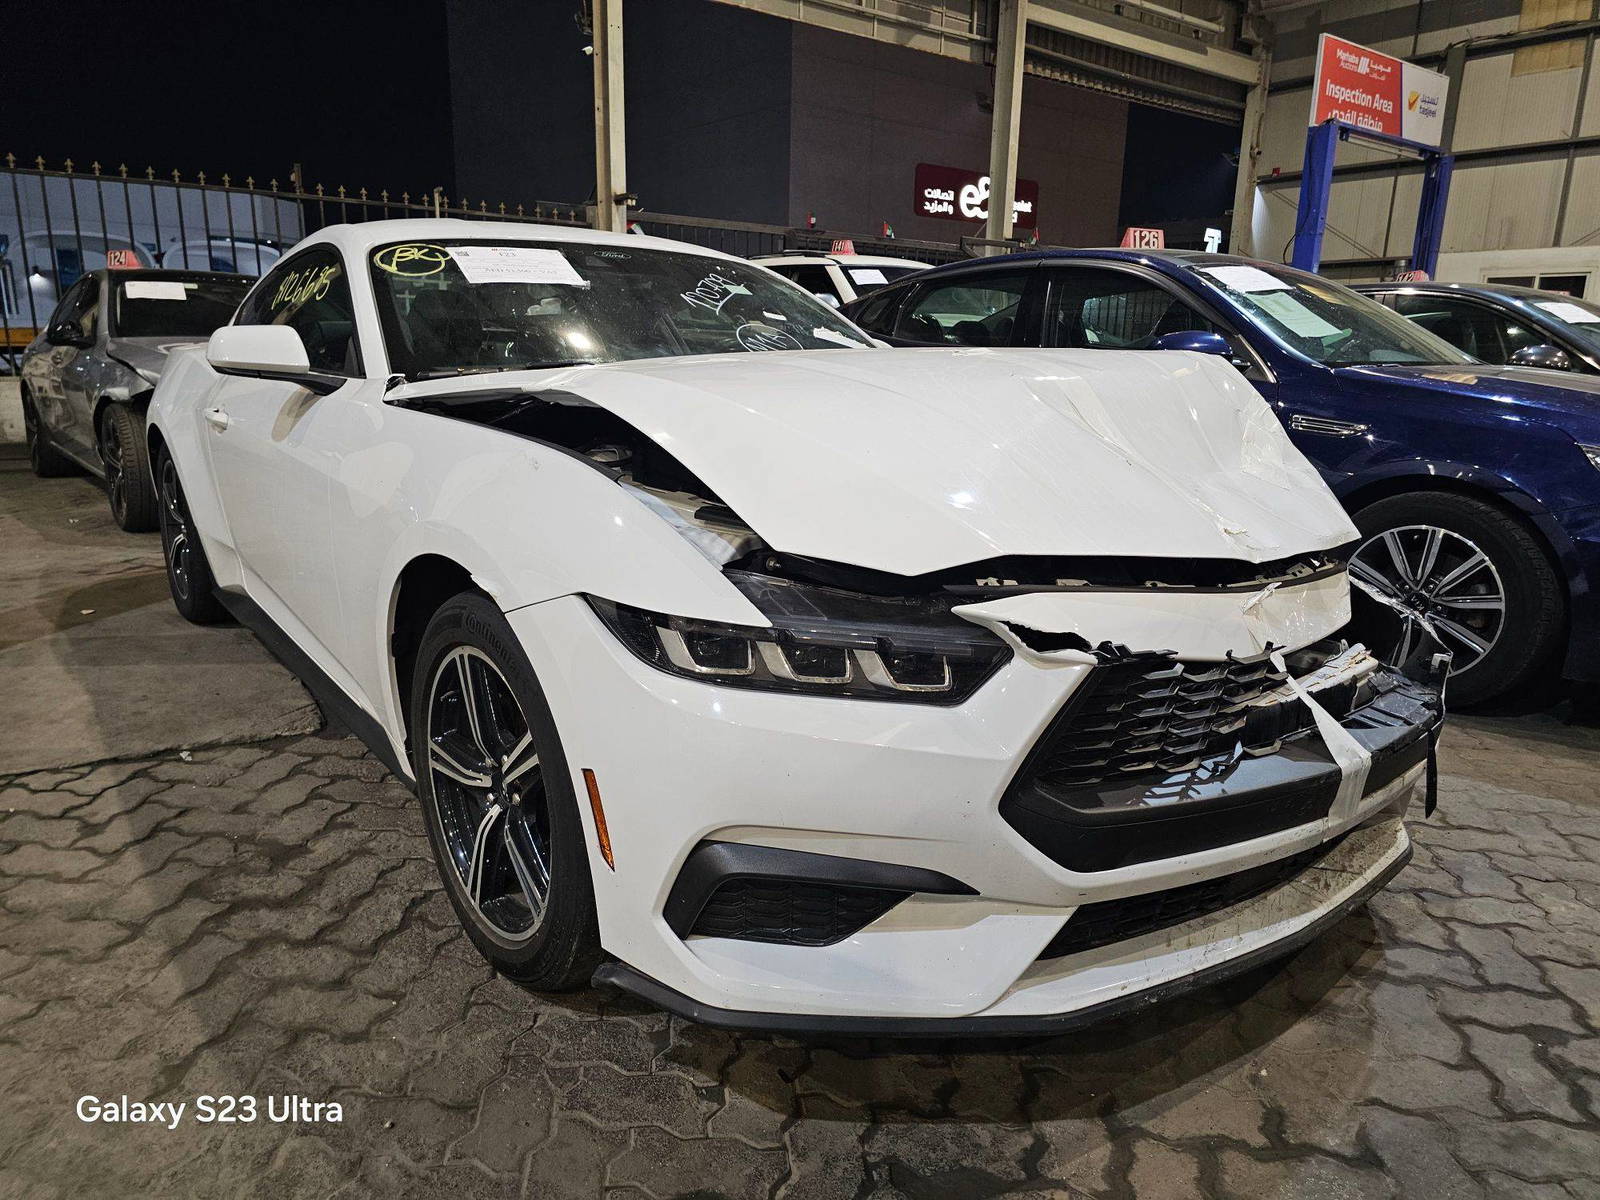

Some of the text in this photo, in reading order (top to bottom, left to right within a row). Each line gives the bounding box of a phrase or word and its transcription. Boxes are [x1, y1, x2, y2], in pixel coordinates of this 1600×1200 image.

[1326, 79, 1393, 113] Inspection Area
[1134, 230, 1159, 249] 126
[110, 251, 126, 267] 124
